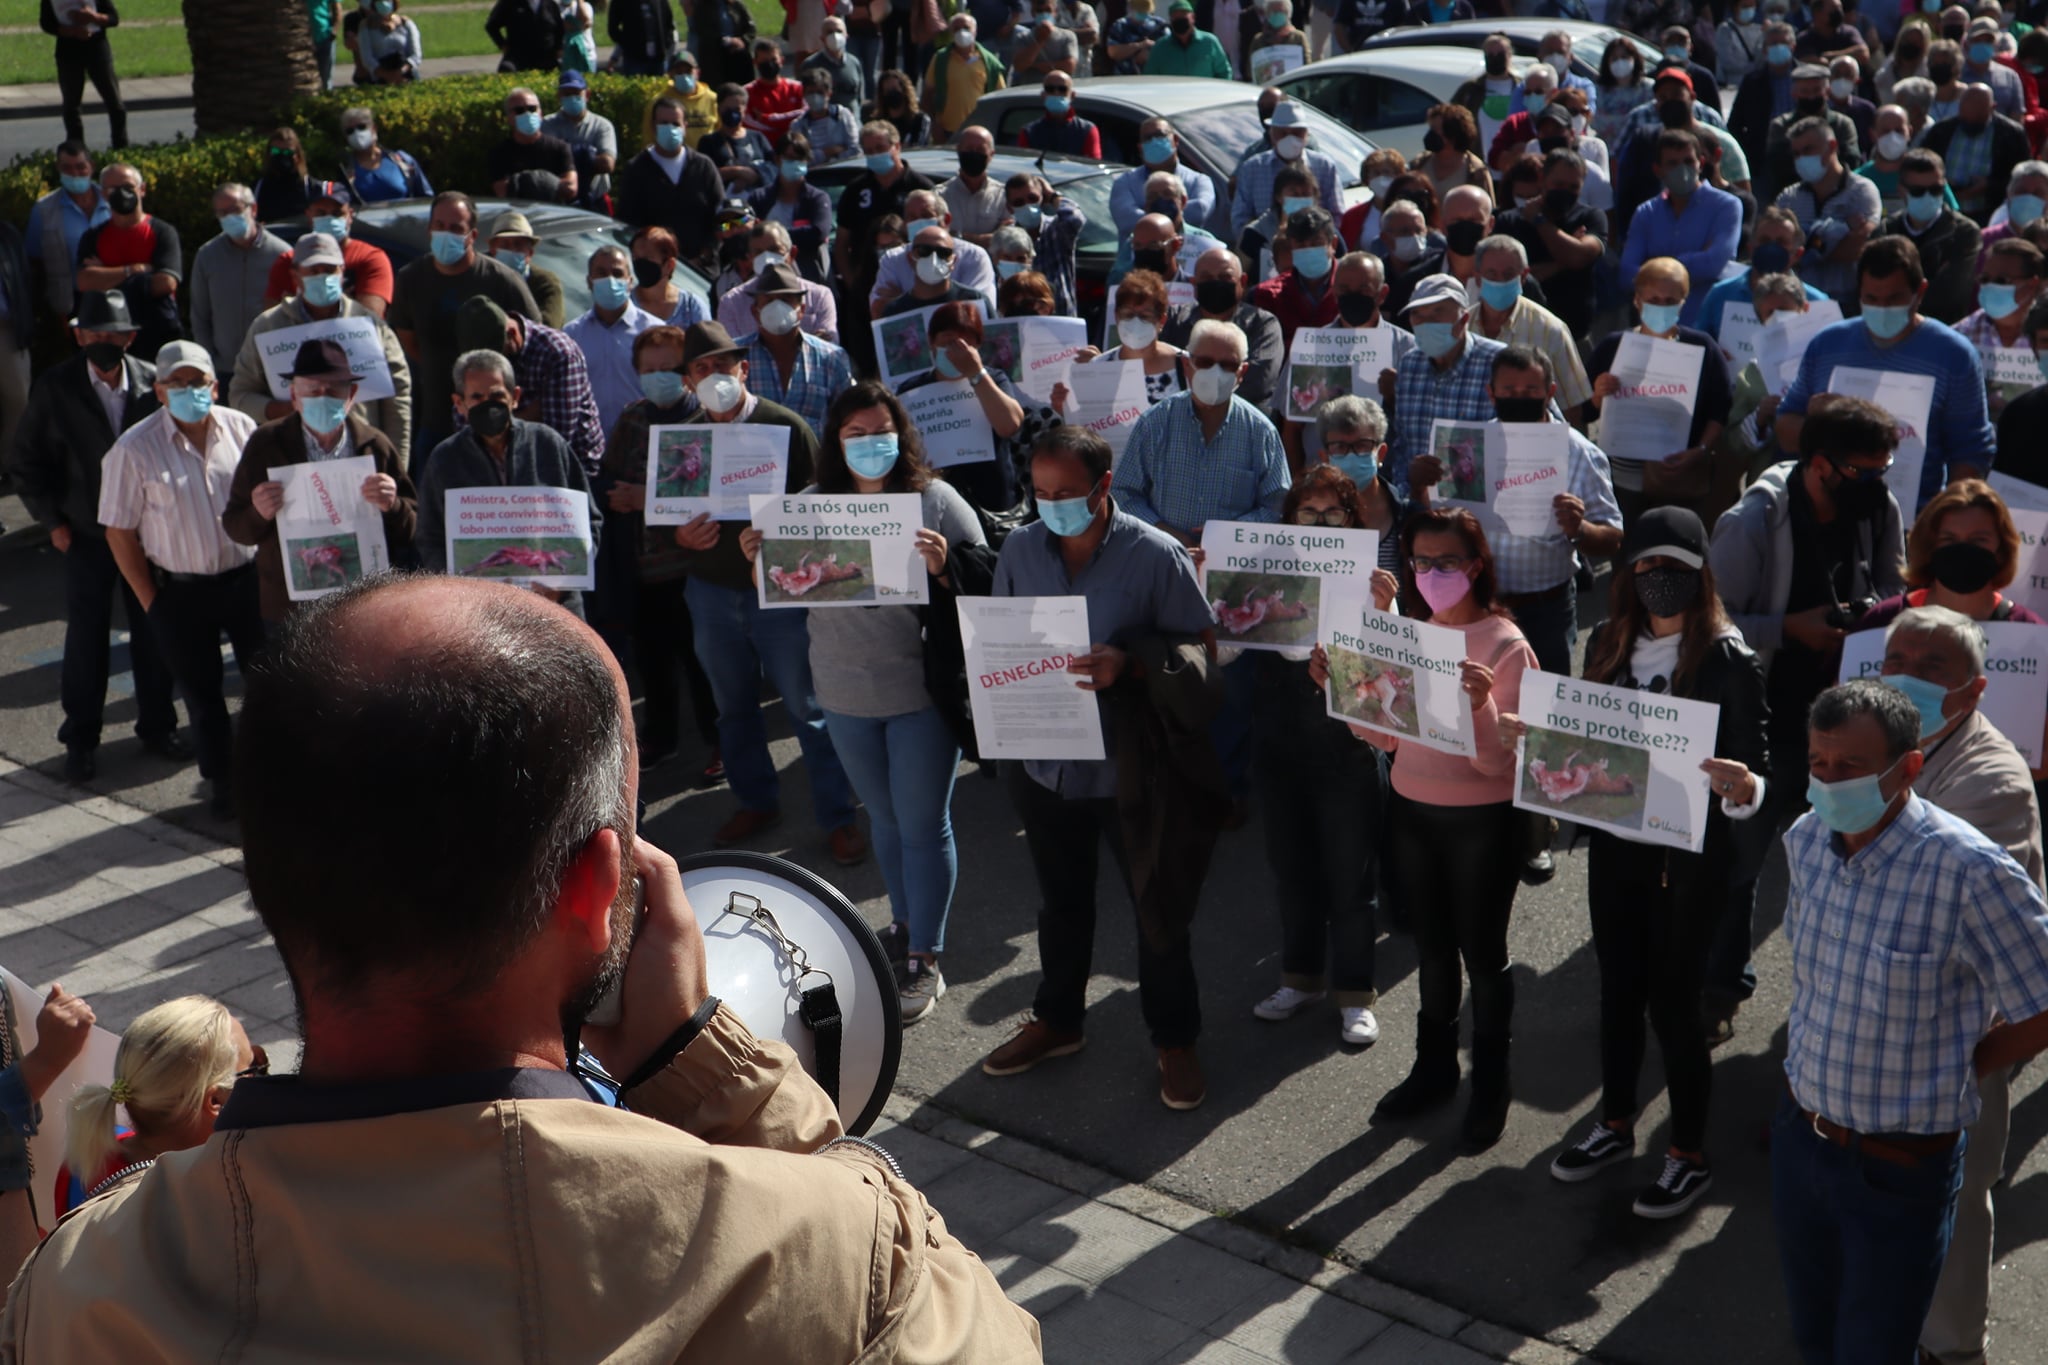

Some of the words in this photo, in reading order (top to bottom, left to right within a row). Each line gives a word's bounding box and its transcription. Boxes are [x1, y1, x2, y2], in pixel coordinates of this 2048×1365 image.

[859, 188, 872, 208] 3
[266, 341, 298, 356] Lobo
[348, 330, 371, 340] non
[1335, 335, 1368, 347] quen
[1030, 346, 1079, 371] DENEGADA
[1315, 350, 1377, 366] protexe???
[1986, 369, 2044, 381] protexe
[1613, 384, 1688, 400] DENEGADA
[926, 418, 971, 434] MEDO!!!
[720, 461, 778, 486] DENEGADA
[1495, 466, 1557, 491] DENEGADA
[311, 471, 342, 526] DENEGADA
[460, 494, 508, 505] Ministra,
[511, 494, 572, 506] Conselleira,
[783, 501, 793, 513] E
[798, 503, 807, 513] a
[812, 499, 841, 513] nós
[847, 502, 889, 517] quen
[460, 511, 472, 520] os
[475, 511, 496, 521] que
[498, 509, 558, 519] convivimos
[459, 524, 484, 534] lobo
[487, 525, 507, 533] non
[779, 525, 808, 536] nos
[814, 522, 902, 541] protexe???
[1235, 528, 1245, 543] E
[1250, 532, 1259, 543] a
[1264, 531, 1295, 546] nós
[1300, 535, 1344, 551] quen
[1227, 556, 1258, 568] nos
[1263, 557, 1355, 575] protexe???
[1362, 611, 1398, 635] Lobo
[1402, 624, 1418, 644] si,
[1333, 631, 1365, 650] pero
[1369, 641, 1394, 658] sen
[1398, 649, 1456, 676] riscos!!!
[979, 652, 1077, 688] DENEGADA
[1860, 660, 1883, 678] pe
[1984, 657, 2037, 675] cos!!!
[1556, 683, 1566, 699] E
[1572, 690, 1582, 703] a
[1587, 692, 1622, 711] nós
[1628, 700, 1679, 722] quen
[1547, 712, 1580, 730] nos
[1586, 720, 1689, 752] protexe???
